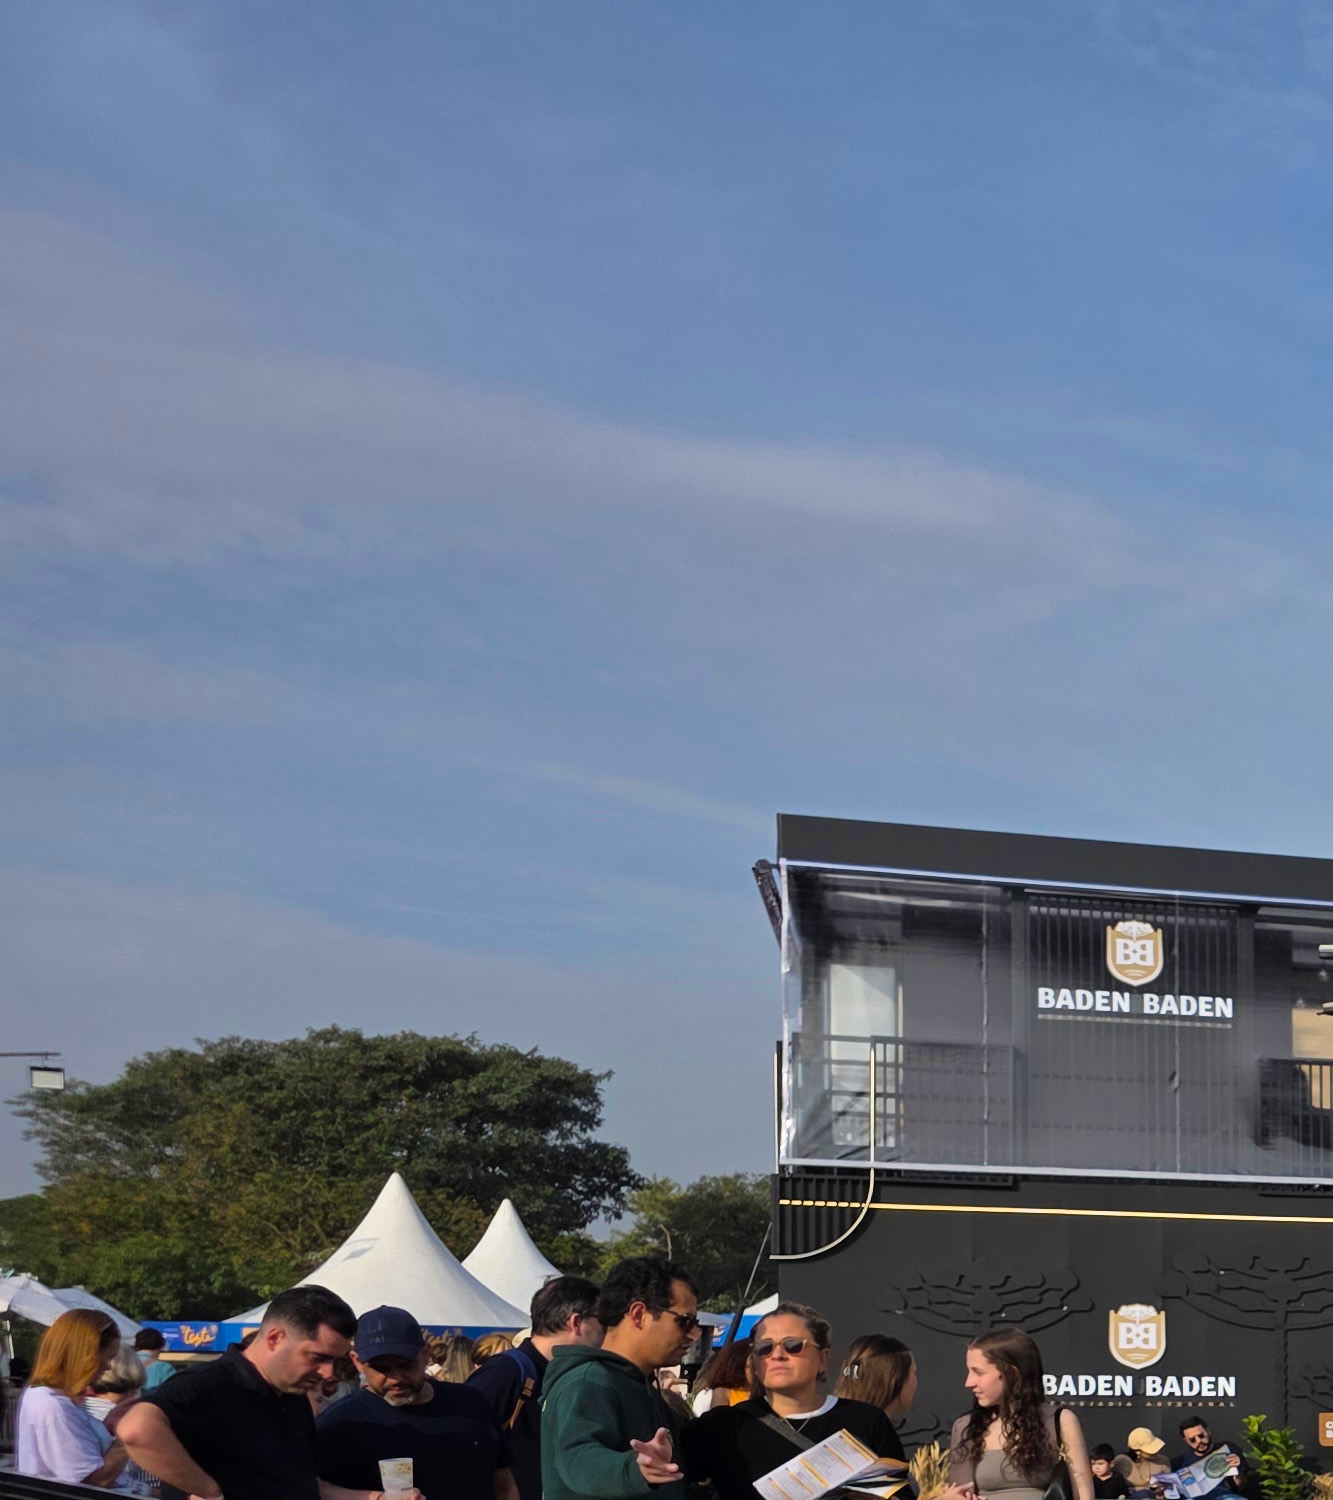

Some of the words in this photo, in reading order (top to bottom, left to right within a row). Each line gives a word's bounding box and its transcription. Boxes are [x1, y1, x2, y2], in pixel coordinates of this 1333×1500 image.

[1037, 987, 1131, 1013] BADEN
[1143, 993, 1234, 1019] BADEN
[1042, 1374, 1133, 1397] BADEN
[1145, 1375, 1236, 1398] BADEN
